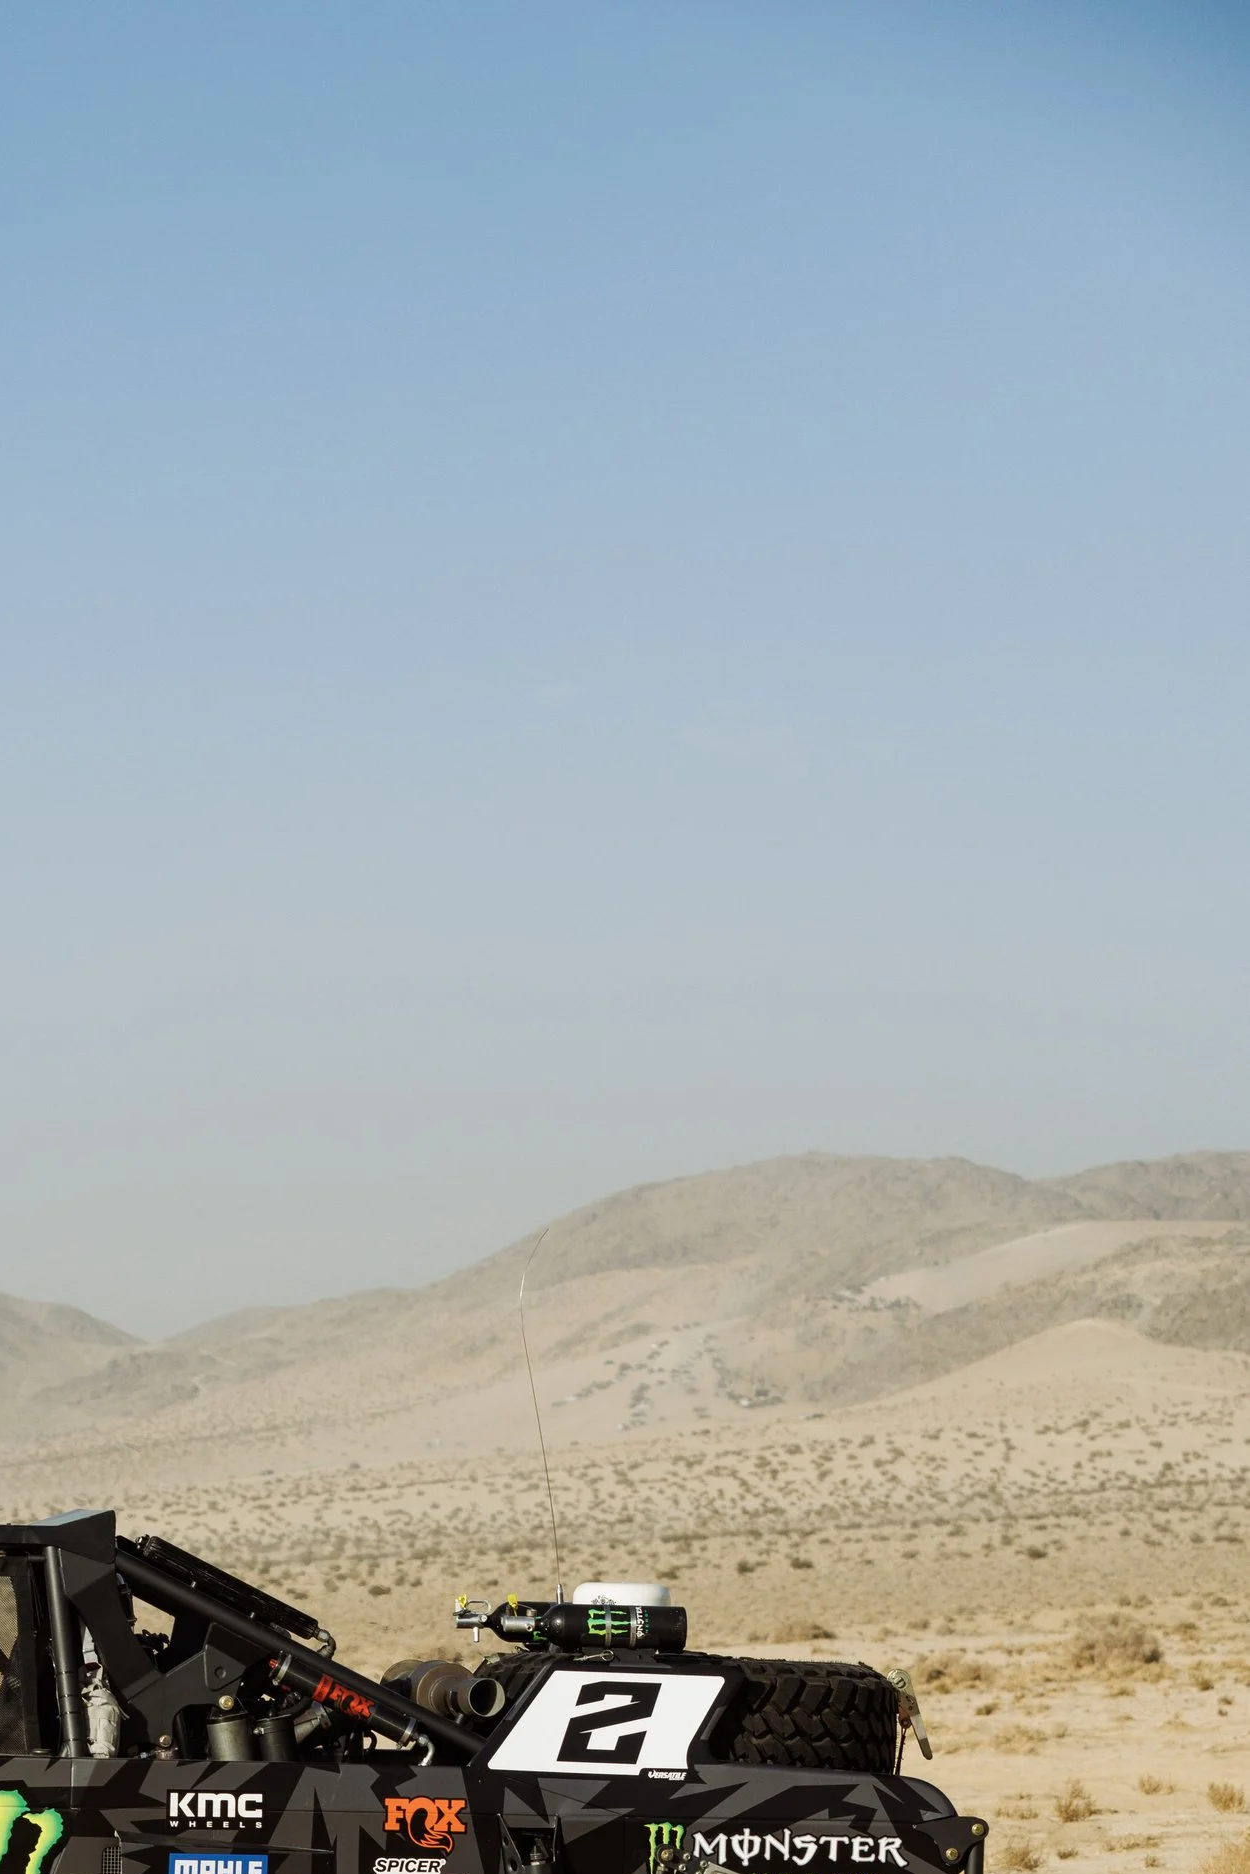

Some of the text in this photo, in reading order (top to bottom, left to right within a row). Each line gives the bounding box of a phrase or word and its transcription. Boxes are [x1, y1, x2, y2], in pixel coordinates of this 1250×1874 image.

[330, 1684, 375, 1718] FOX
[557, 1681, 662, 1764] 2
[170, 1793, 263, 1818] KMC
[170, 1821, 262, 1829] WHEELS
[384, 1797, 466, 1850] FOX
[693, 1828, 909, 1867] MONSTER
[375, 1859, 441, 1873] SPICER
